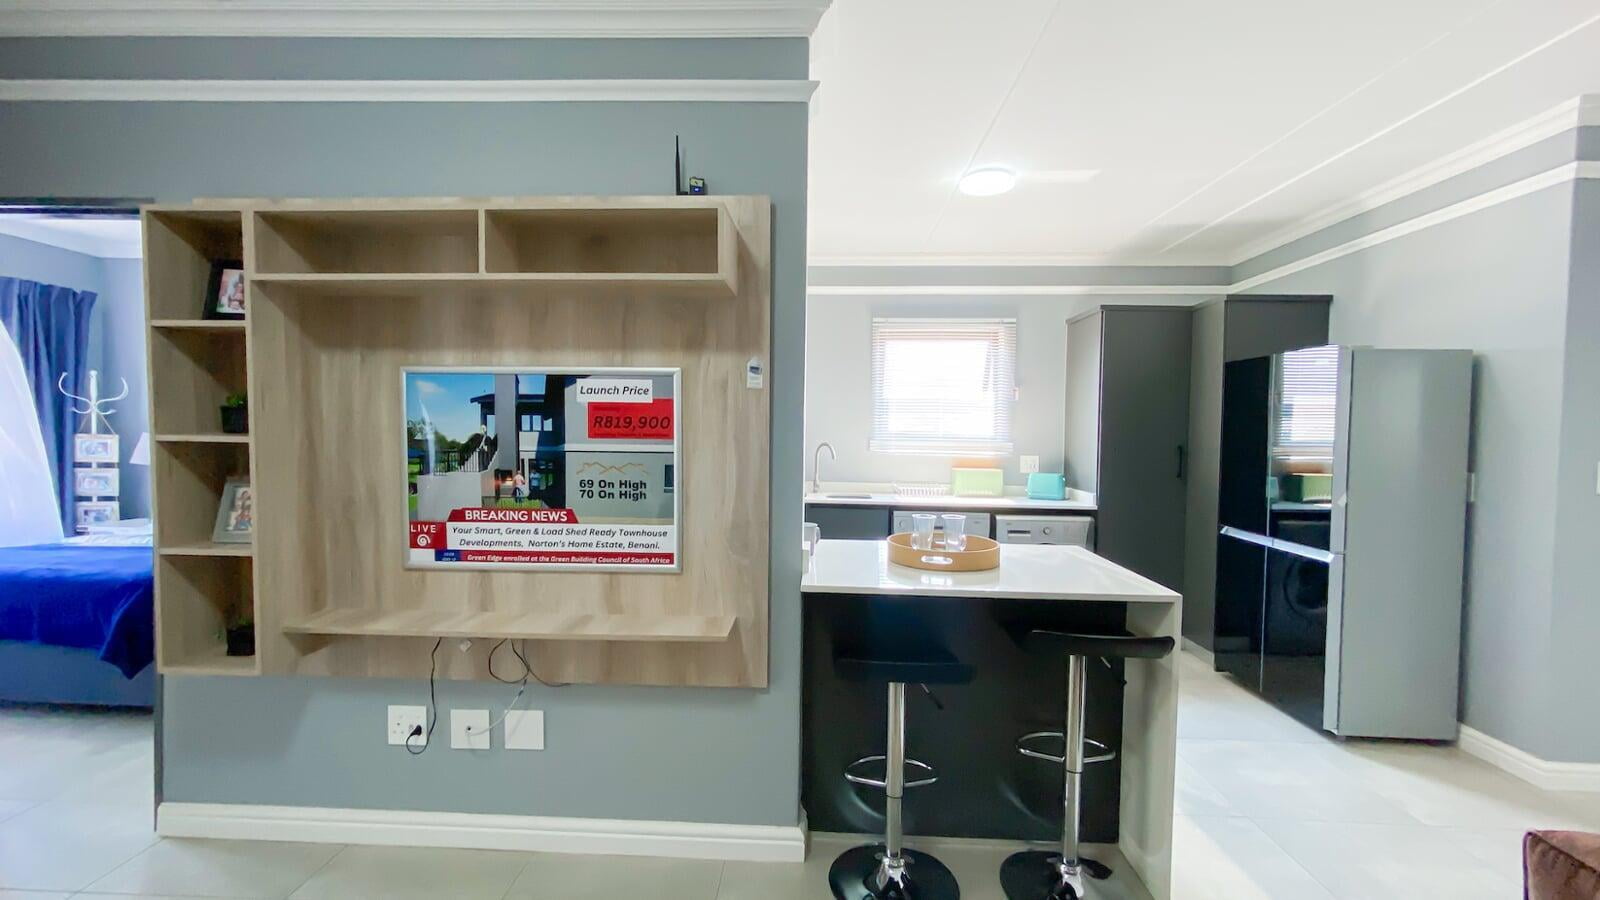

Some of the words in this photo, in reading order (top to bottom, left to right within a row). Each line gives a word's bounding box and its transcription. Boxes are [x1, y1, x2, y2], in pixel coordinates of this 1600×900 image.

[580, 386, 619, 395] Launch
[622, 386, 649, 395] Price
[593, 416, 671, 431] R819,900
[579, 480, 594, 488] 69
[598, 480, 615, 489] On
[619, 480, 647, 491] High
[579, 490, 594, 499] 70
[598, 490, 615, 499] On
[619, 490, 647, 501] High
[465, 510, 528, 521] BREAKING
[532, 511, 568, 521] NEWS
[411, 524, 436, 533] LIVE
[474, 527, 503, 535] Smart,
[565, 528, 588, 536] Shed
[589, 528, 616, 537] Ready
[619, 529, 668, 537] Townhouse
[459, 539, 524, 548] Developments,
[528, 540, 566, 548] Norton's
[595, 541, 625, 549] Estate,
[627, 541, 660, 549] Benoni.
[487, 554, 503, 562] Edge
[571, 556, 597, 564] Building
